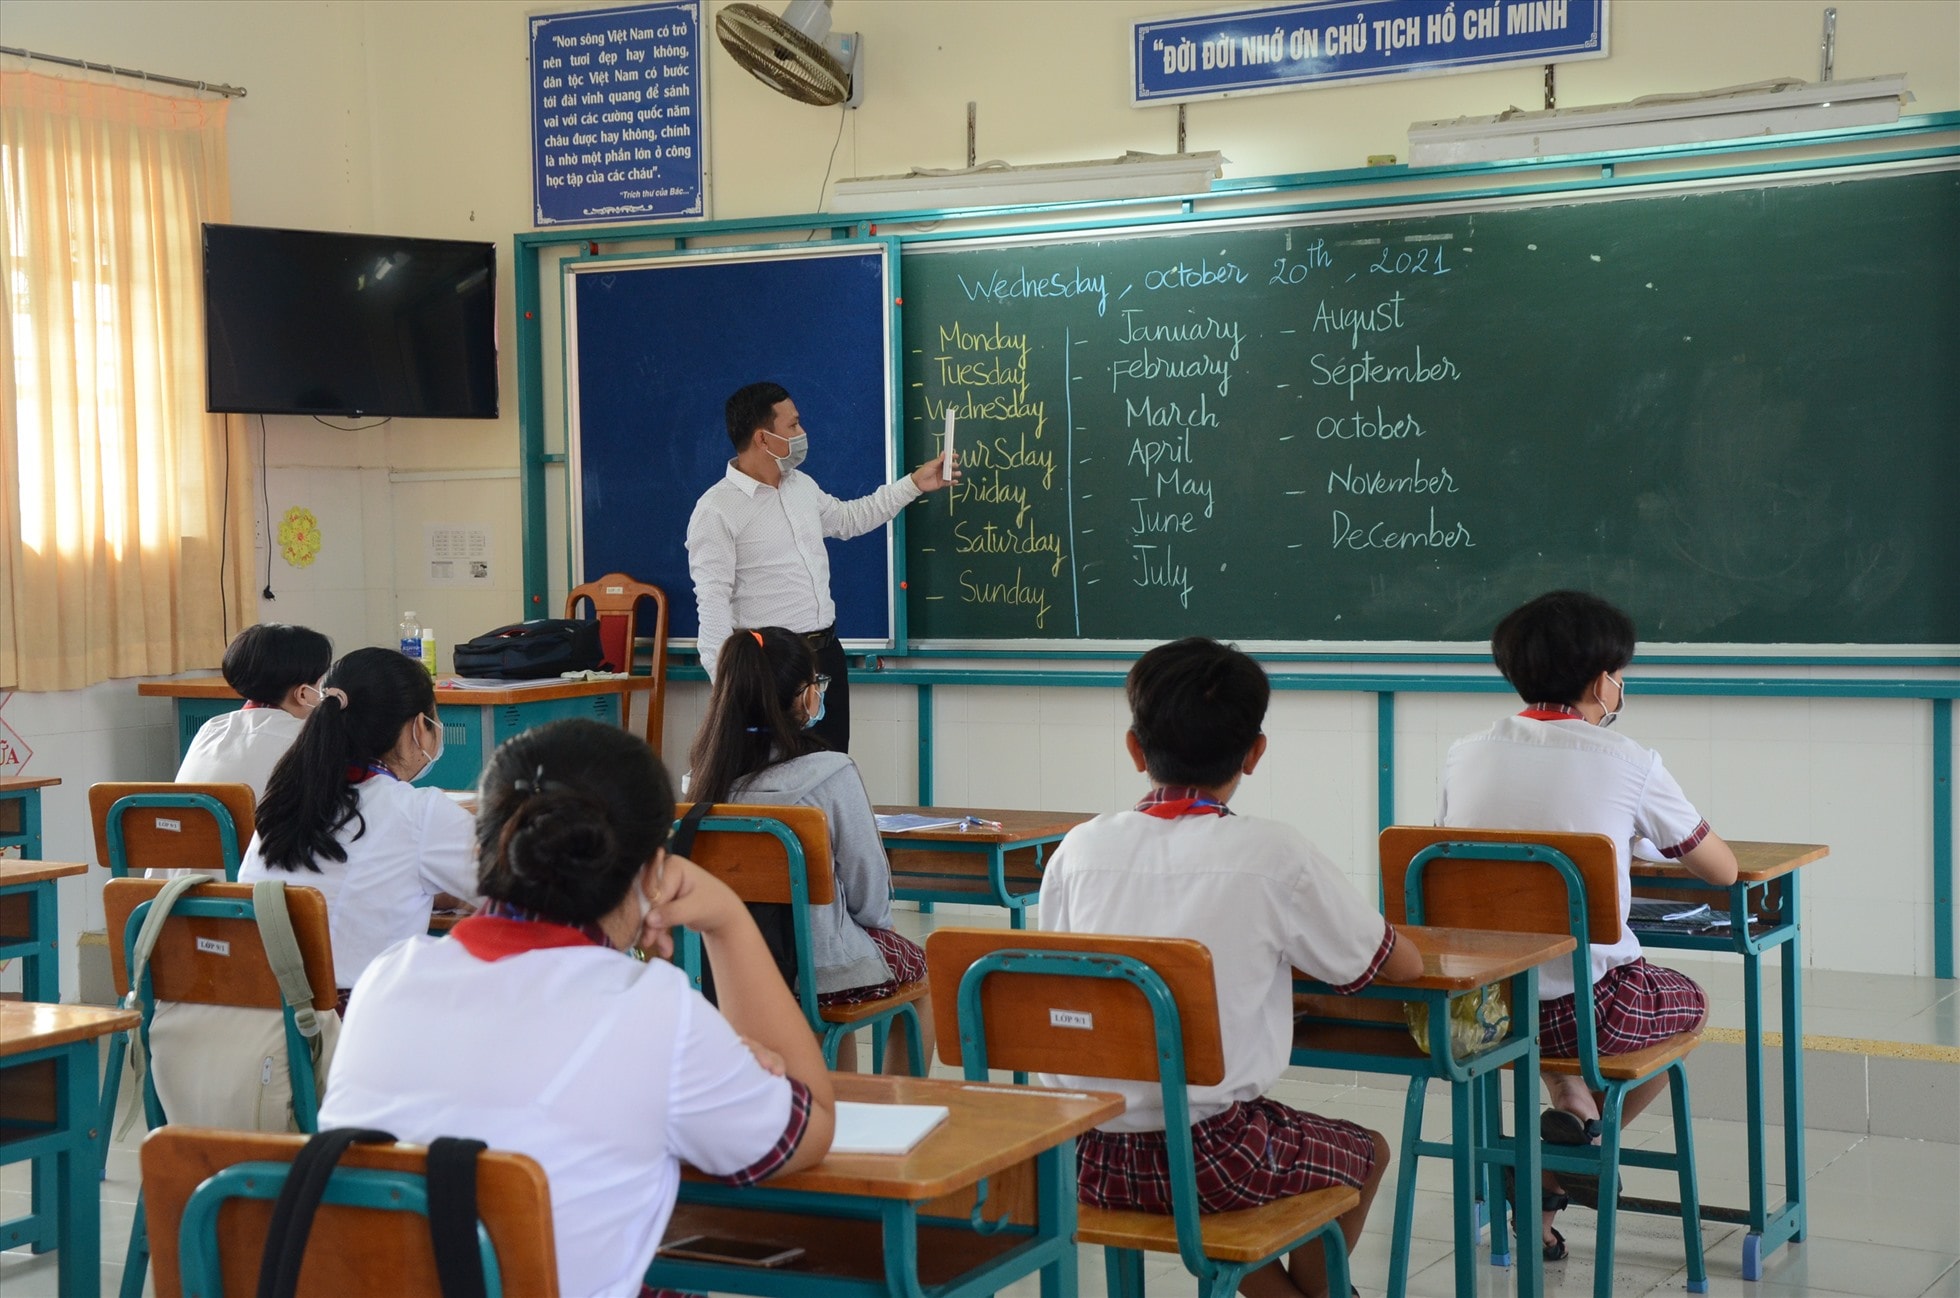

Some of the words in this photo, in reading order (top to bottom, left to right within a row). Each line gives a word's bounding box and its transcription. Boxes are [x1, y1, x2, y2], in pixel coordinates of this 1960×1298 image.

[580, 33, 605, 46] sông
[607, 29, 627, 44] Việt
[630, 28, 654, 40] Nam
[657, 24, 669, 38] có
[672, 22, 687, 36] trở
[1202, 33, 1236, 70] ĐỜI
[1242, 27, 1285, 66] NHỚ
[1290, 27, 1319, 61] ƠN
[1325, 13, 1367, 56] CHỦ
[1373, 16, 1420, 56] TỊCH
[1427, 2, 1456, 45] HỒ
[1463, 1, 1500, 40] CHÍ
[543, 56, 562, 69] nên
[570, 52, 590, 66] tươi
[598, 50, 618, 66] đẹp
[626, 48, 645, 63] hay
[653, 44, 689, 59] không,
[543, 75, 562, 89] dân
[568, 73, 584, 89] tộc
[588, 71, 609, 86] Việt
[614, 69, 639, 82] Nam
[645, 66, 657, 79] có
[663, 63, 689, 77] bước
[543, 95, 557, 108] tới
[561, 93, 577, 107] đài
[581, 91, 604, 105] vinh
[608, 90, 641, 105] quang
[646, 83, 659, 99] để
[663, 83, 690, 98] sánh
[543, 115, 559, 128] vai
[562, 113, 577, 126] với
[581, 111, 599, 125] các
[602, 109, 633, 124] cường
[637, 104, 663, 122] quốc
[666, 105, 690, 118] năm
[544, 134, 569, 147] châu
[572, 132, 598, 147] được
[600, 130, 619, 145] hay
[622, 128, 658, 142] không,
[661, 124, 690, 138] chính
[545, 155, 555, 167] là
[558, 153, 578, 166] nhờ
[582, 151, 602, 166] một
[634, 147, 651, 160] lớn
[655, 145, 662, 158] ở
[665, 145, 691, 159] công
[546, 174, 564, 189] học
[567, 173, 583, 187] tập
[586, 170, 605, 184] của
[607, 169, 625, 182] các
[1370, 246, 1451, 275] 2021
[1119, 309, 1247, 361] January
[1313, 290, 1405, 350] August
[939, 320, 1032, 370] Monday
[1113, 347, 1232, 397] February
[1310, 344, 1461, 401] September
[1126, 393, 1220, 428] March
[1128, 427, 1193, 477] April
[1157, 468, 1215, 519] May
[1328, 458, 1459, 495] November
[950, 469, 1031, 529] Friday
[1131, 498, 1197, 534] June
[954, 517, 1068, 577] Saturday
[960, 566, 1051, 629] Sunday
[1133, 544, 1194, 609] July
